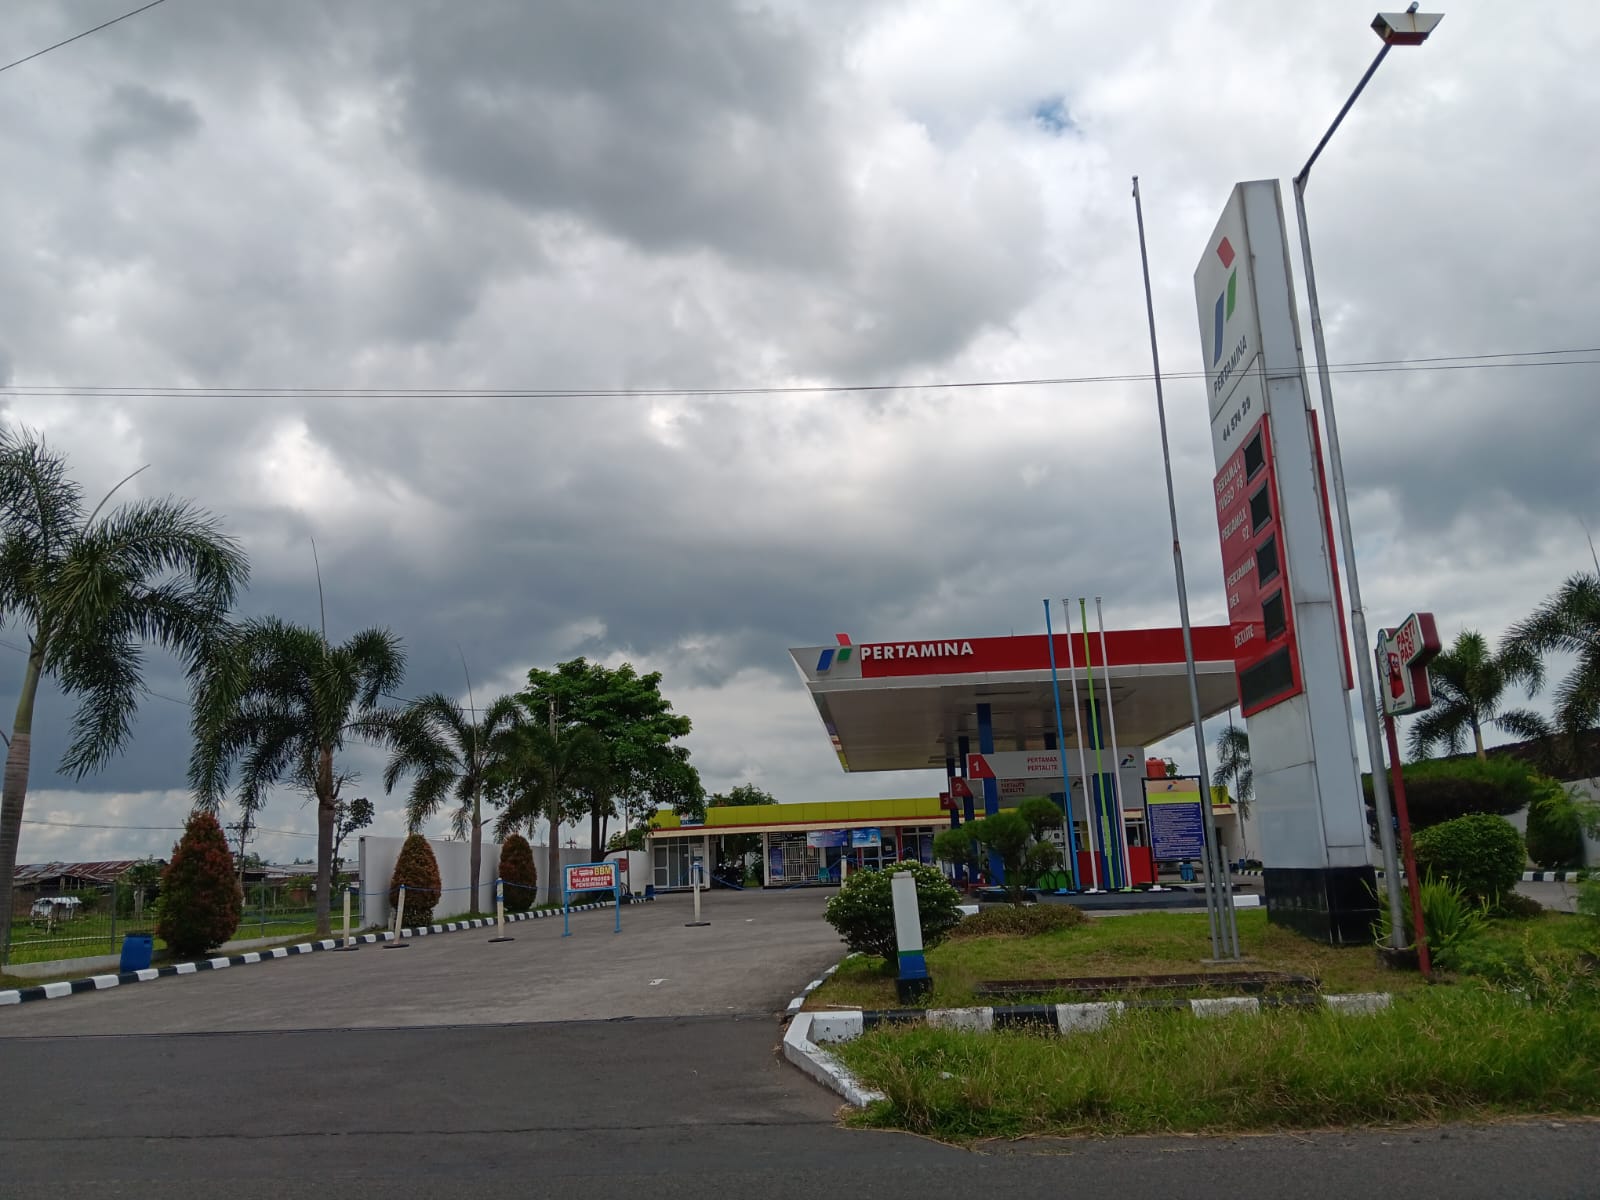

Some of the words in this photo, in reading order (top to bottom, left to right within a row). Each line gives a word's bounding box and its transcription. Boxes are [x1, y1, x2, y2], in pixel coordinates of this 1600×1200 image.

[1214, 335, 1247, 397] PERTAMINA
[1216, 457, 1241, 495] PERTAMAX
[1222, 507, 1247, 543] PERTAMAX
[1227, 557, 1255, 588] PERTAMINA
[1230, 592, 1240, 608] DEX
[1234, 623, 1254, 649] DEXLITE
[1397, 619, 1415, 649] PASTI
[861, 641, 974, 661] PERTAMINA
[973, 761, 980, 771] 1
[594, 866, 611, 876] BBM
